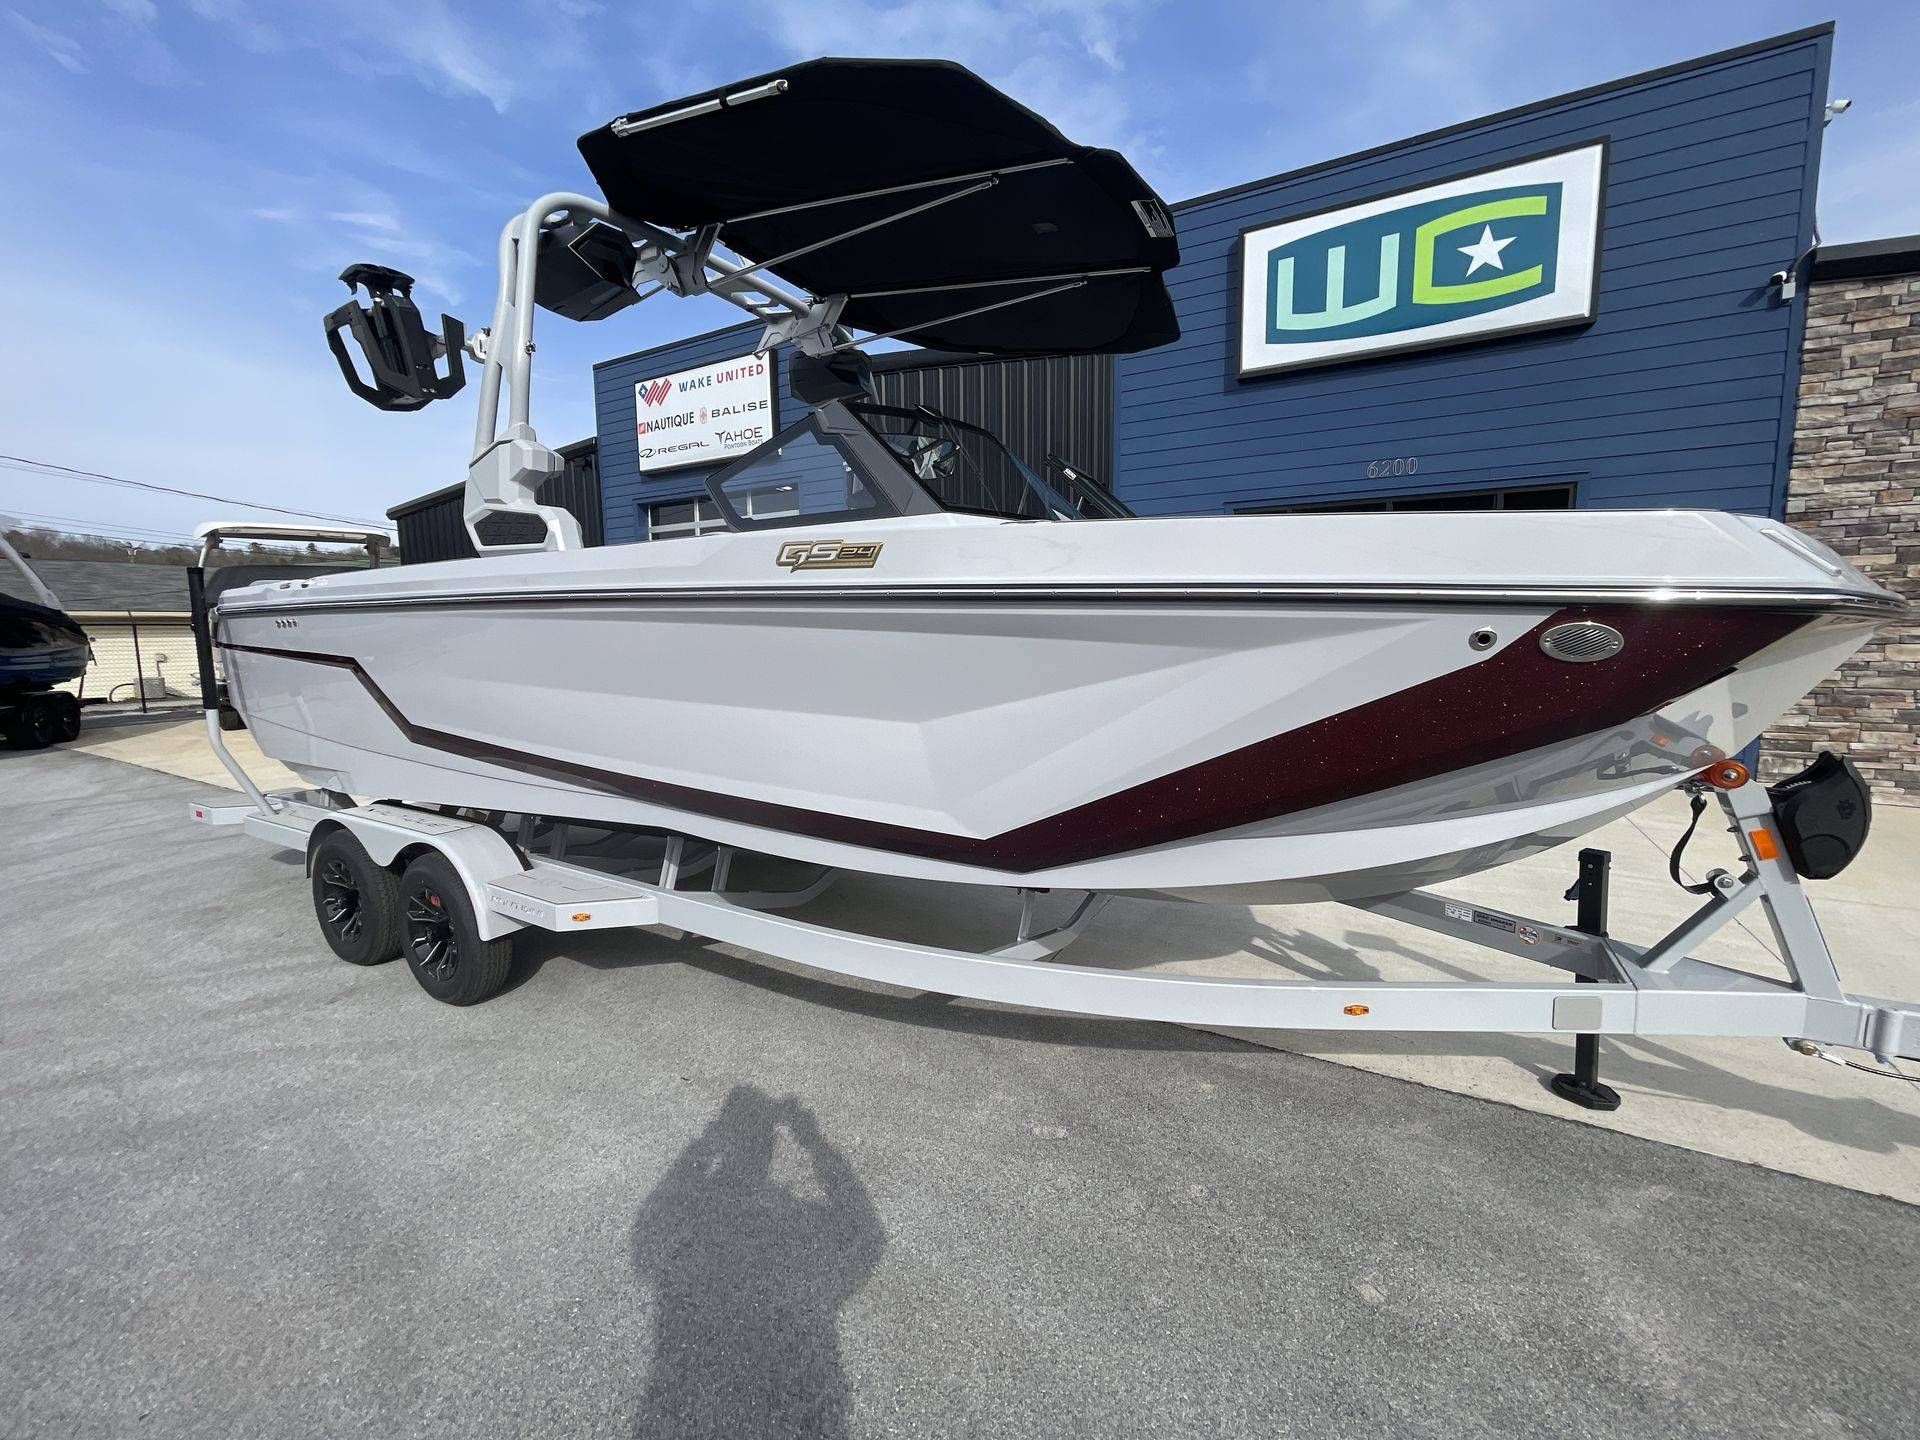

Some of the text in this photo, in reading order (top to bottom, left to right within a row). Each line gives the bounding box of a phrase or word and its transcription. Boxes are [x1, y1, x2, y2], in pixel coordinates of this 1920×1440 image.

[678, 363, 764, 393] WAKE UNITED
[711, 399, 768, 418] BALISE
[646, 411, 695, 433] NAUTIQUE
[714, 426, 763, 445] TAHOE
[657, 441, 711, 455] REGAL
[1366, 457, 1419, 479] 6200
